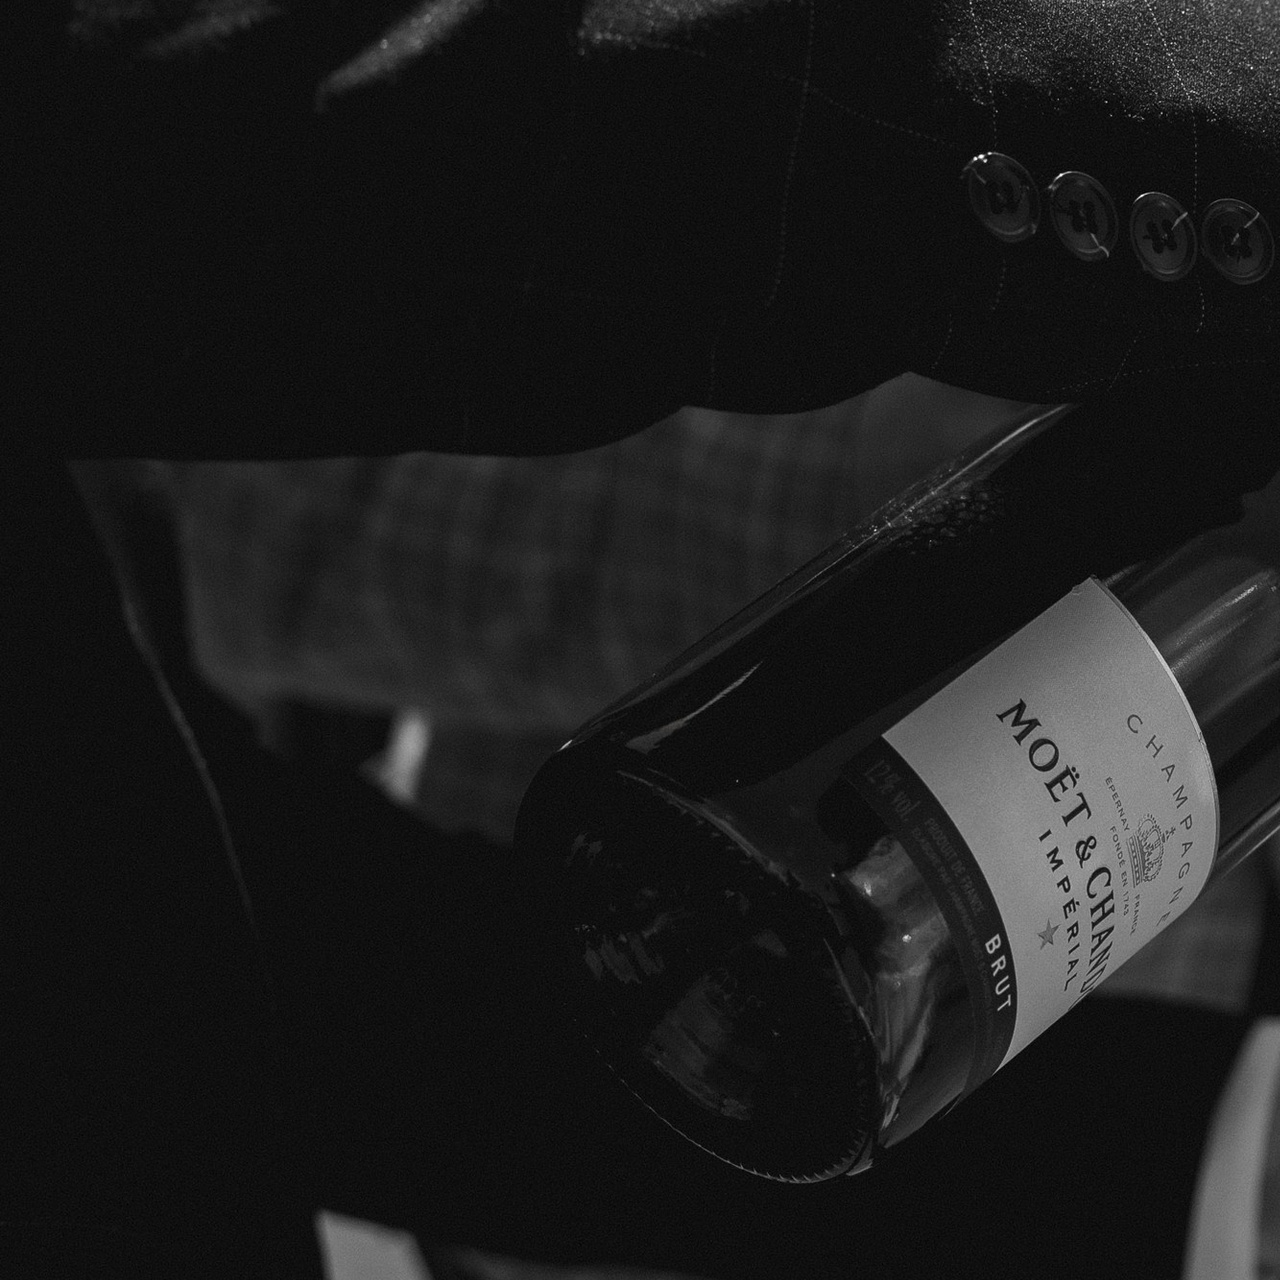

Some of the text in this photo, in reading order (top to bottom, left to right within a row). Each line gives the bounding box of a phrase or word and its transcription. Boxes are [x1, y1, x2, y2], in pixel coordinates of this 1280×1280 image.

[996, 698, 1115, 1011] MOËT & CHAND
[1104, 776, 1130, 831] ÉPERNAY
[1126, 713, 1193, 927] CHAMPAGNE
[984, 932, 1013, 1013] BRUT
[1038, 829, 1081, 993] IMPÉRIAL
